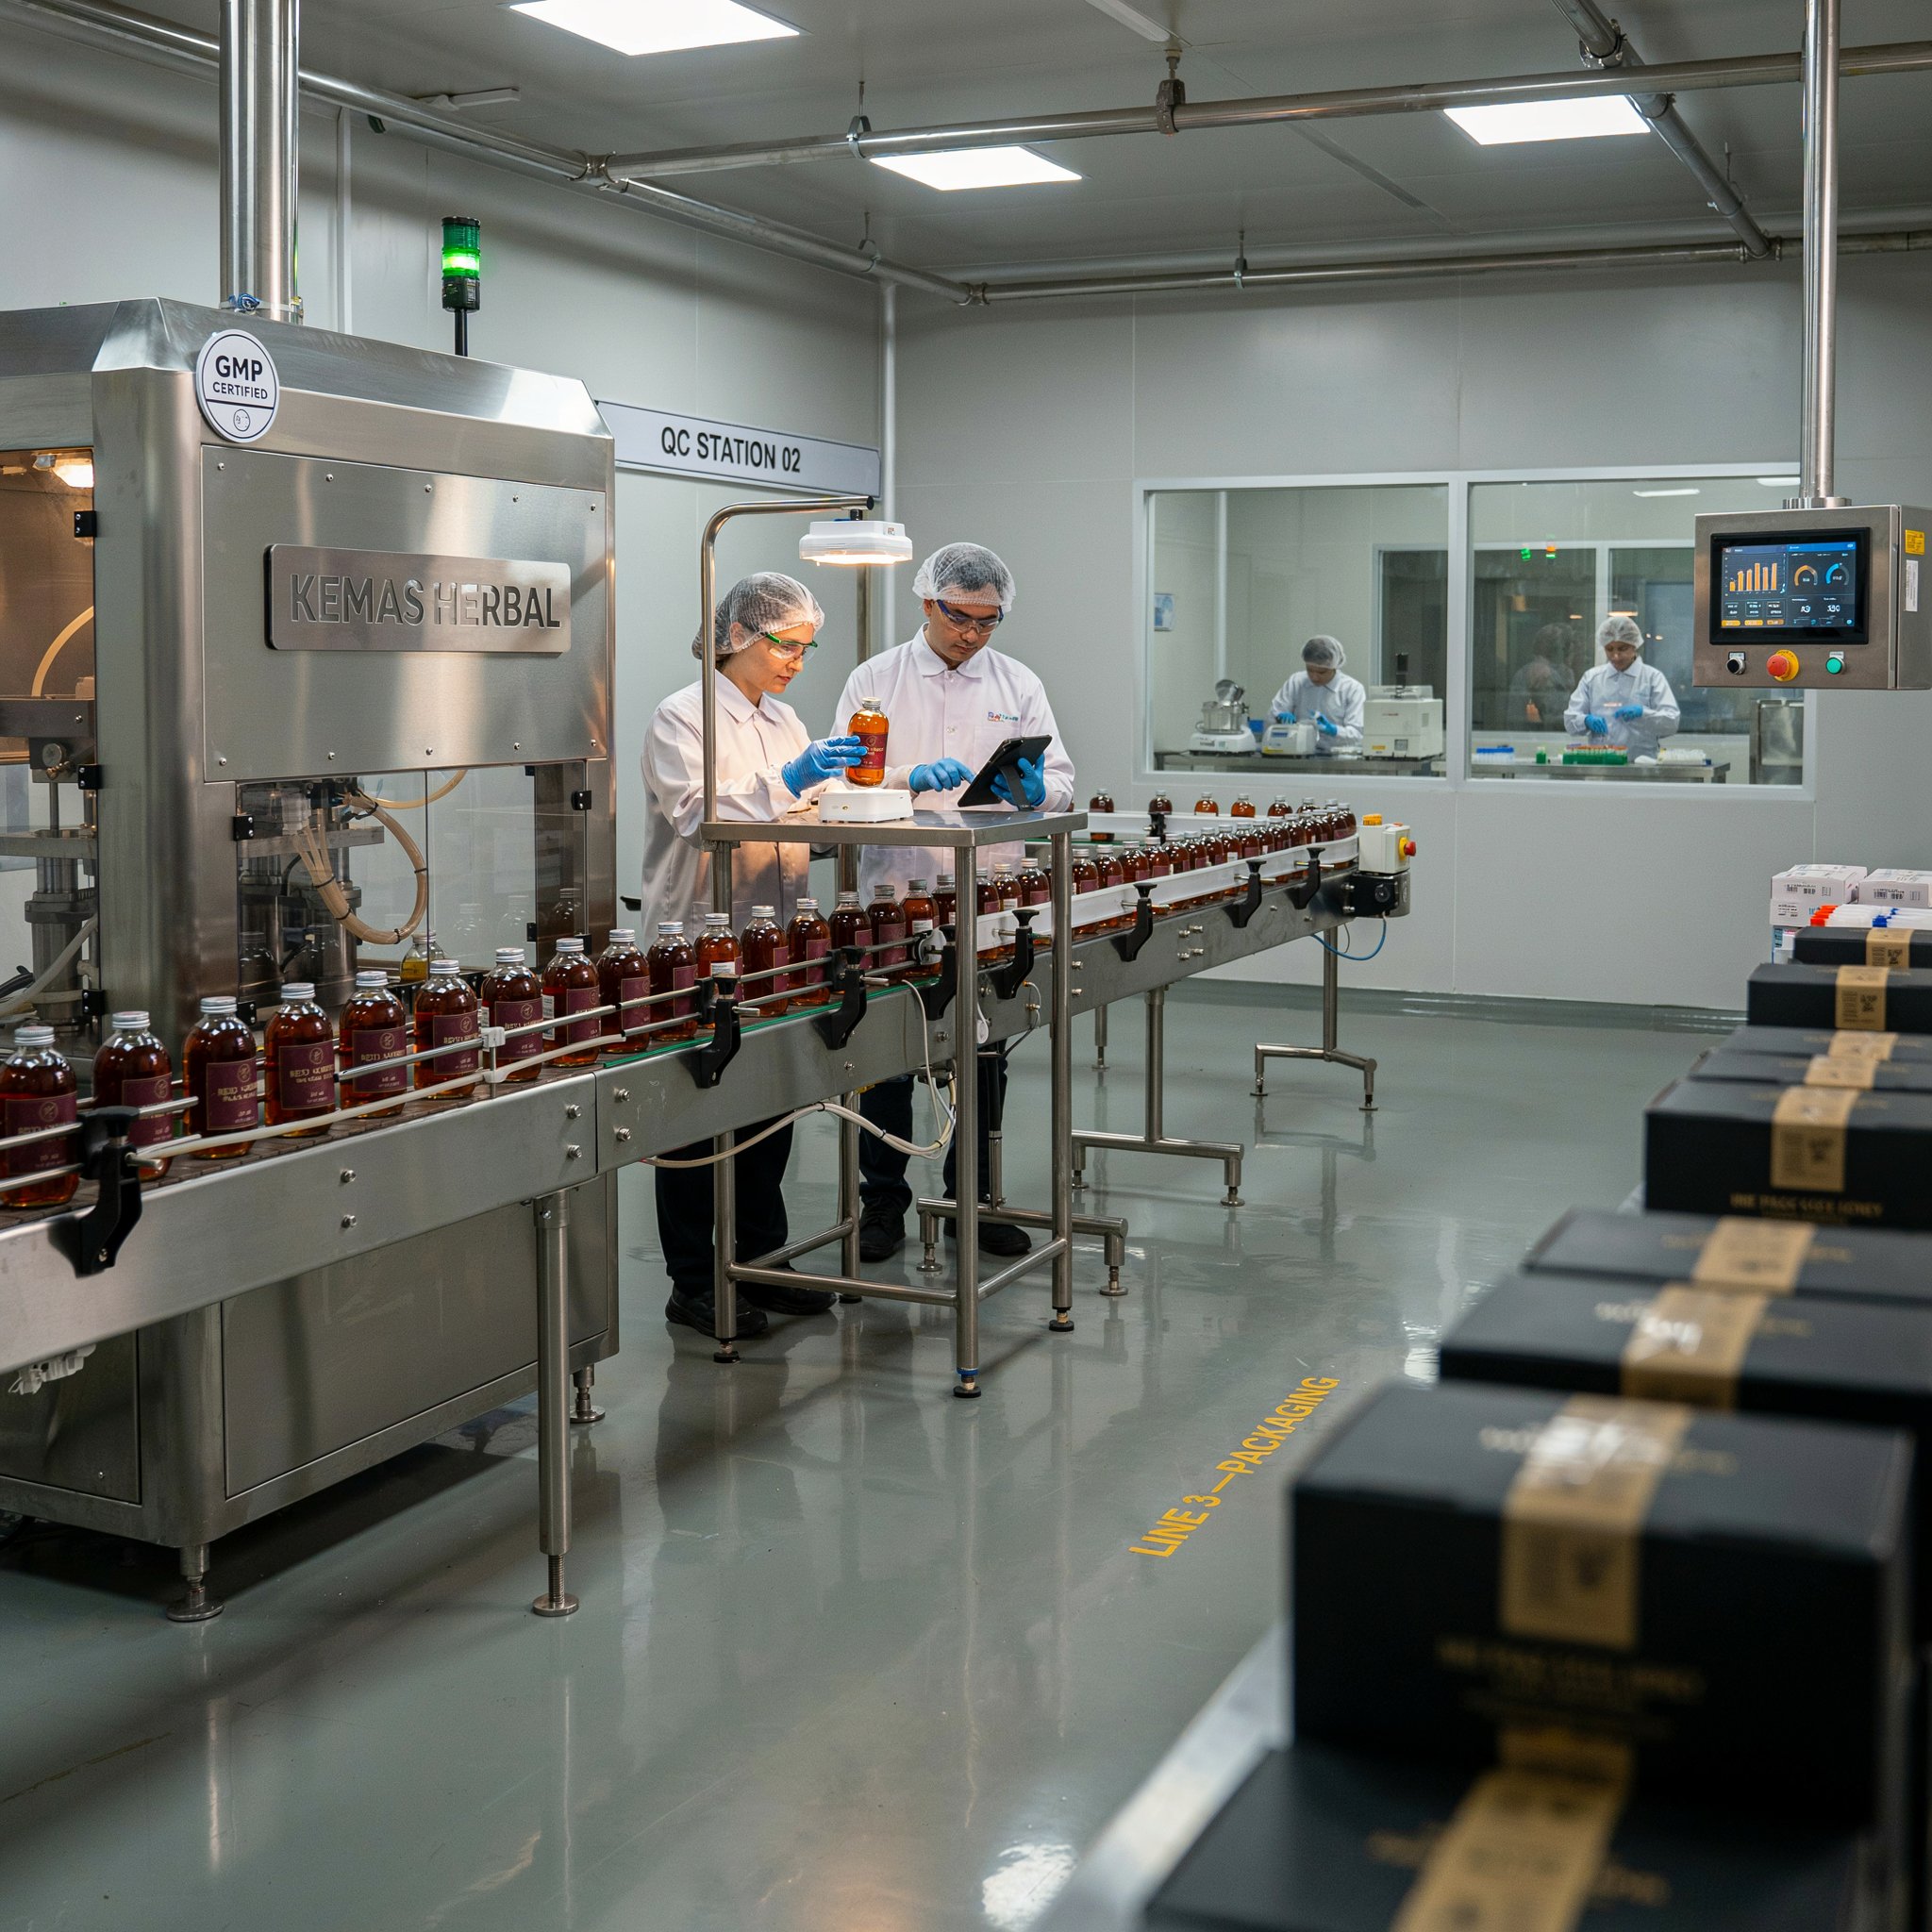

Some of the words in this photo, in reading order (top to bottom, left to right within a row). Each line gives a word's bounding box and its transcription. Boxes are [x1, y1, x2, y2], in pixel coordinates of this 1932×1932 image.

[212, 381, 268, 400] CERTIFIED
[215, 355, 263, 382] GMP
[661, 426, 691, 457] QC
[697, 432, 775, 470] STATION
[782, 446, 802, 473] 02
[291, 574, 425, 626] KEMAS
[433, 581, 562, 628] HERBAL
[1128, 1507, 1210, 1557] LINE
